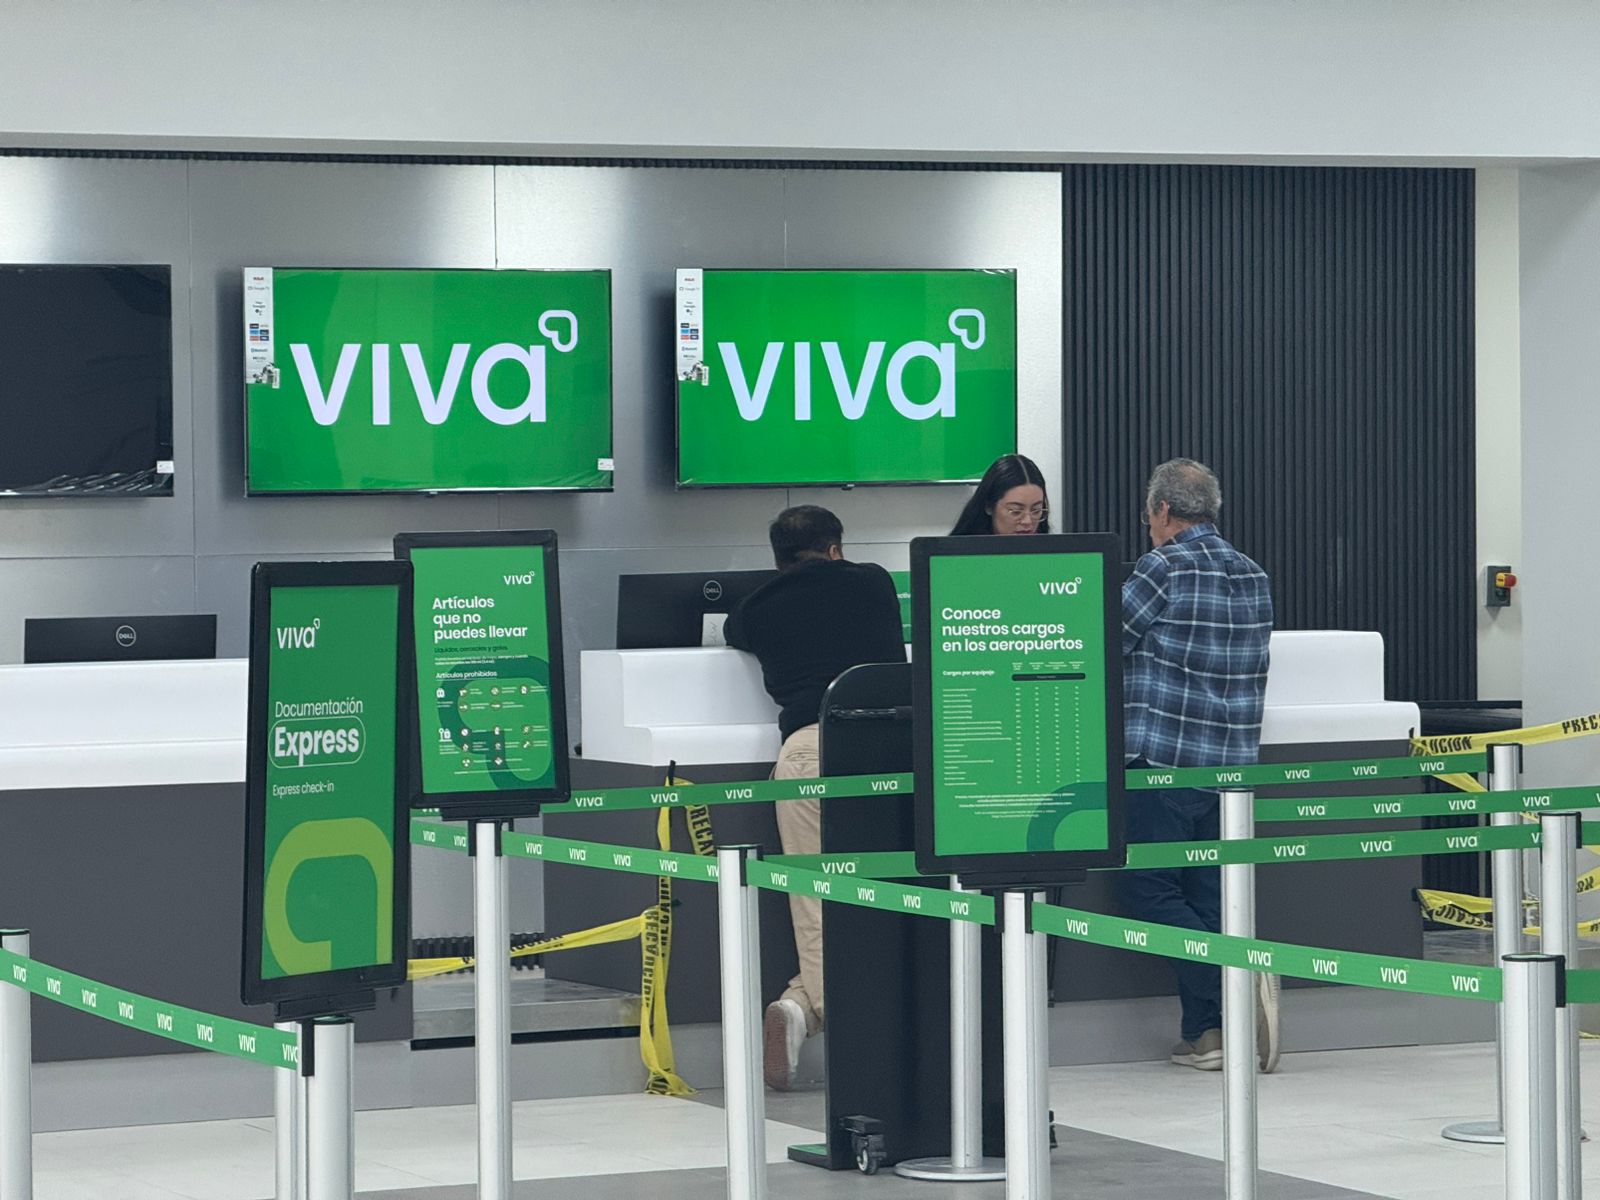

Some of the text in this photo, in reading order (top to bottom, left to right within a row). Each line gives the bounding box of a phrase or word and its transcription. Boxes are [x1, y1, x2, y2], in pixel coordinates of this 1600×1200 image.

[432, 595, 495, 610] Artículos
[433, 613, 481, 628] que no
[942, 607, 1001, 620] Conoce
[434, 625, 528, 644] puedes llevar
[942, 623, 1065, 638] nuestros cargos
[942, 637, 1083, 654] en los aeropuertos
[464, 670, 497, 679] prohibidos
[275, 696, 363, 718] Documentación
[274, 726, 360, 767] Express
[273, 780, 334, 798] Express check-in
[706, 864, 719, 877] viv
